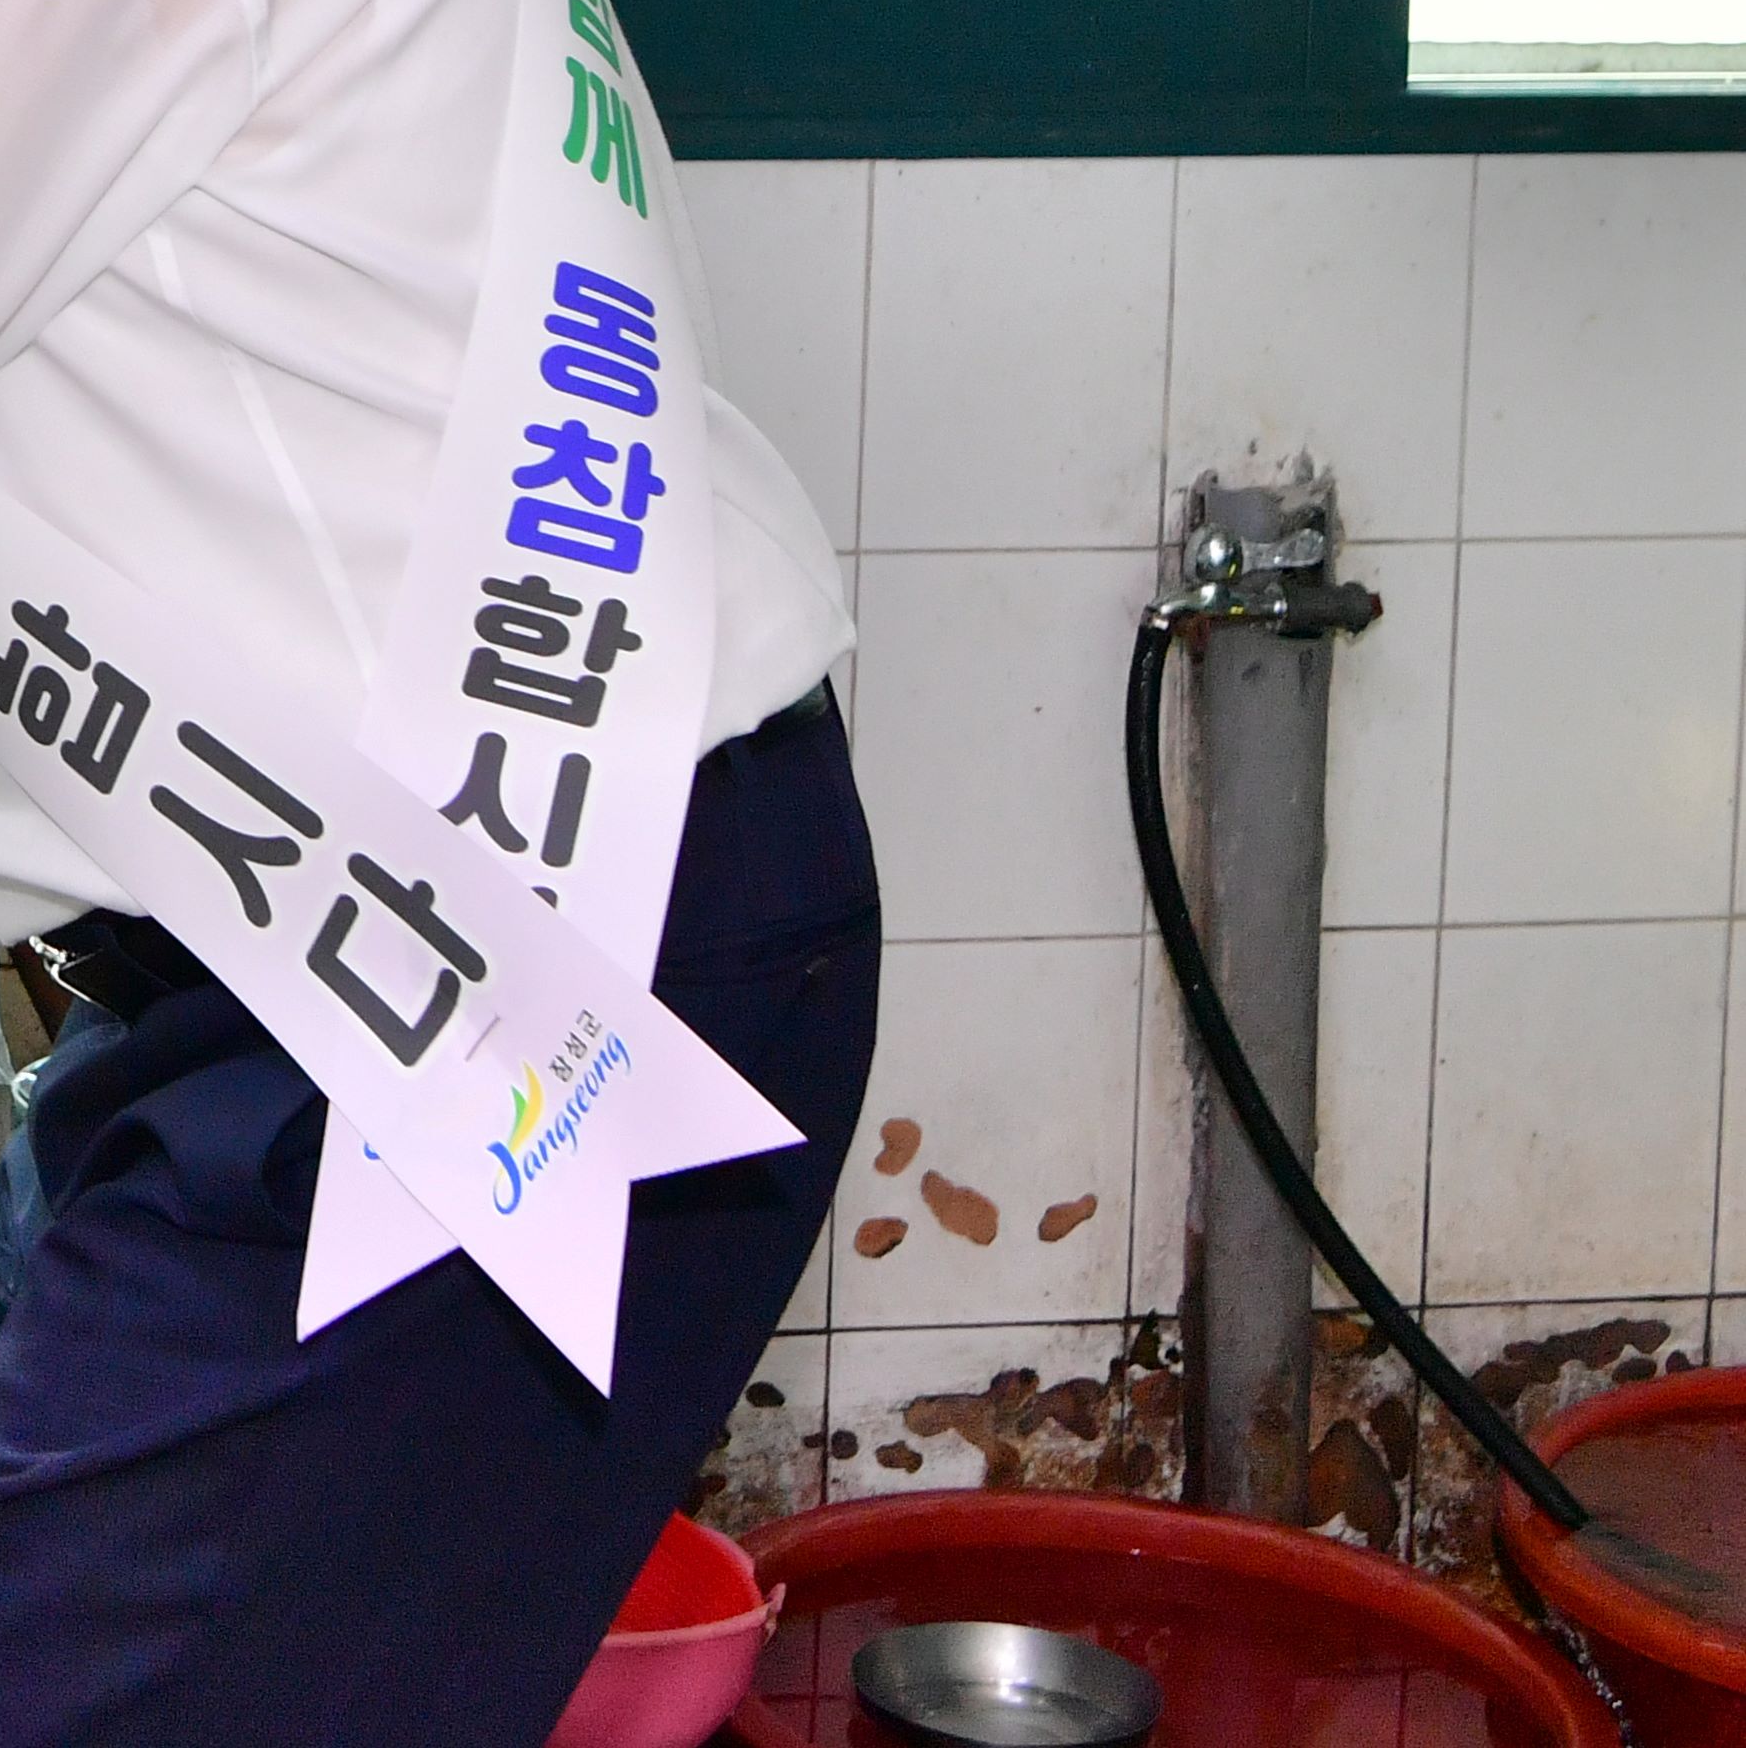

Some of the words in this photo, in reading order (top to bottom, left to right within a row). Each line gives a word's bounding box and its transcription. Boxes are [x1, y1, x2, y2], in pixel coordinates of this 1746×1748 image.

[436, 260, 666, 910] 동참합시
[485, 1031, 633, 1216] Jangseong
[548, 1008, 603, 1084] 장성군
